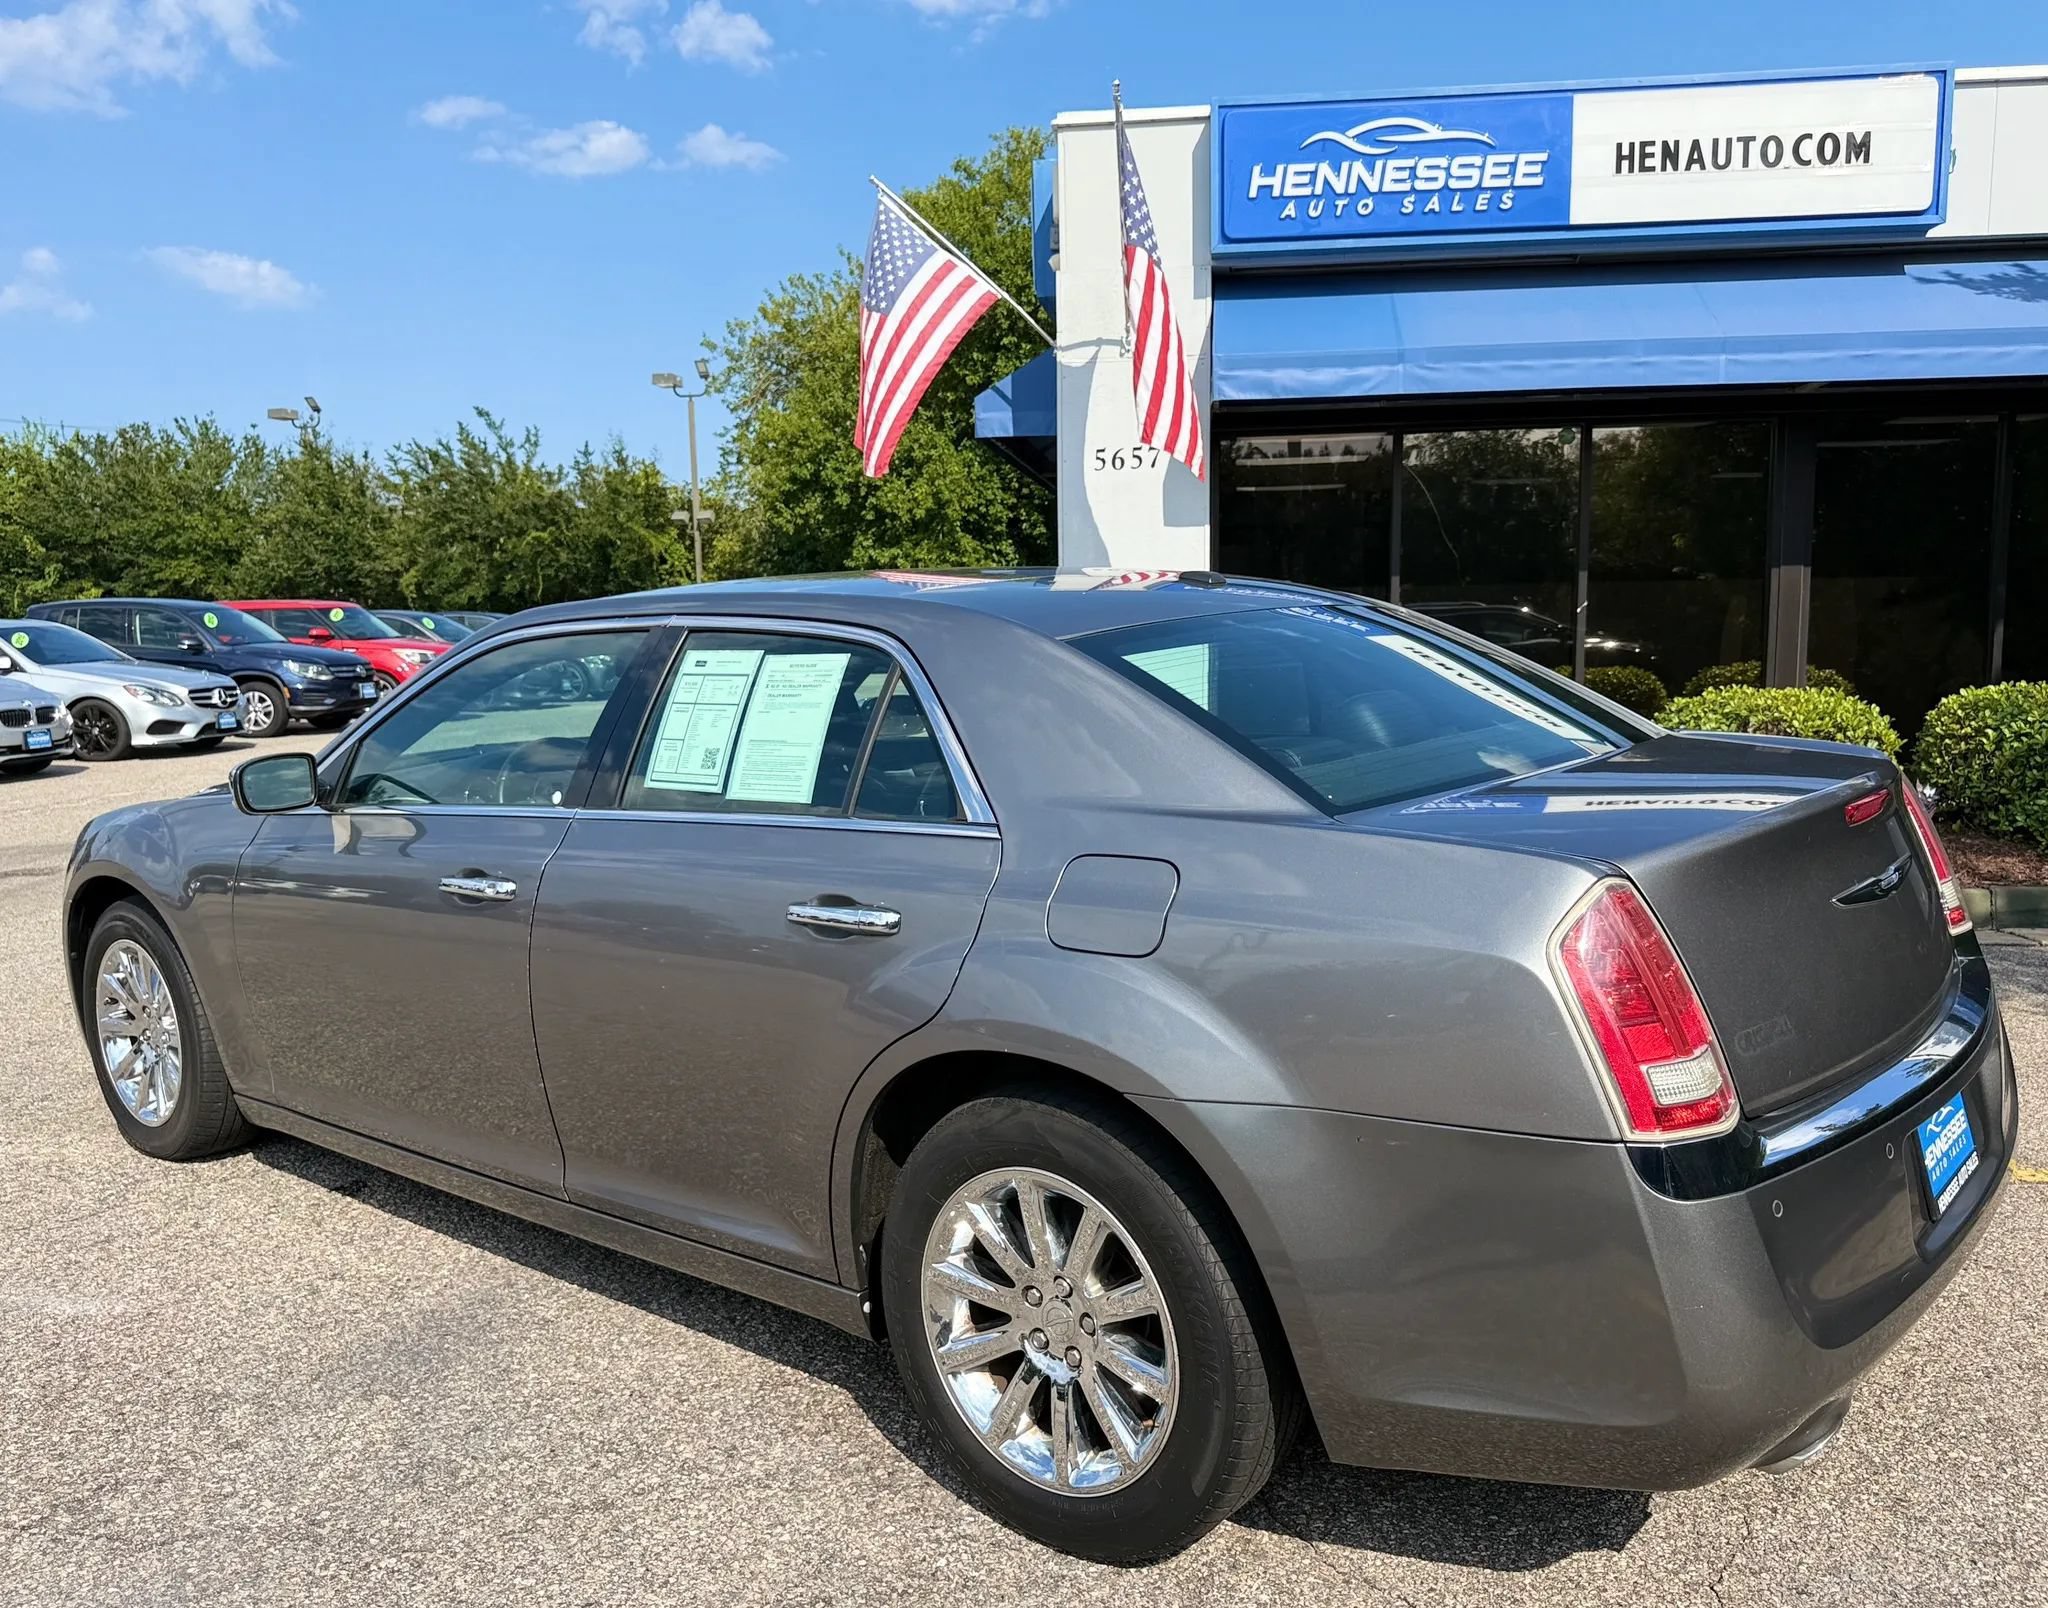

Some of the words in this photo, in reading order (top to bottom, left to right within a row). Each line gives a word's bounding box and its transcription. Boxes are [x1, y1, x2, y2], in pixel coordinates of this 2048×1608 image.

[1248, 150, 1550, 199] HENNESSEE
[1280, 197, 1375, 219] AUTO
[1400, 190, 1515, 214] SALES
[1094, 445, 1160, 471] 5657
[1924, 1108, 1968, 1170] HENNESSEE
[1932, 1157, 1948, 1182] AUTO
[1949, 1134, 1967, 1164] SALES
